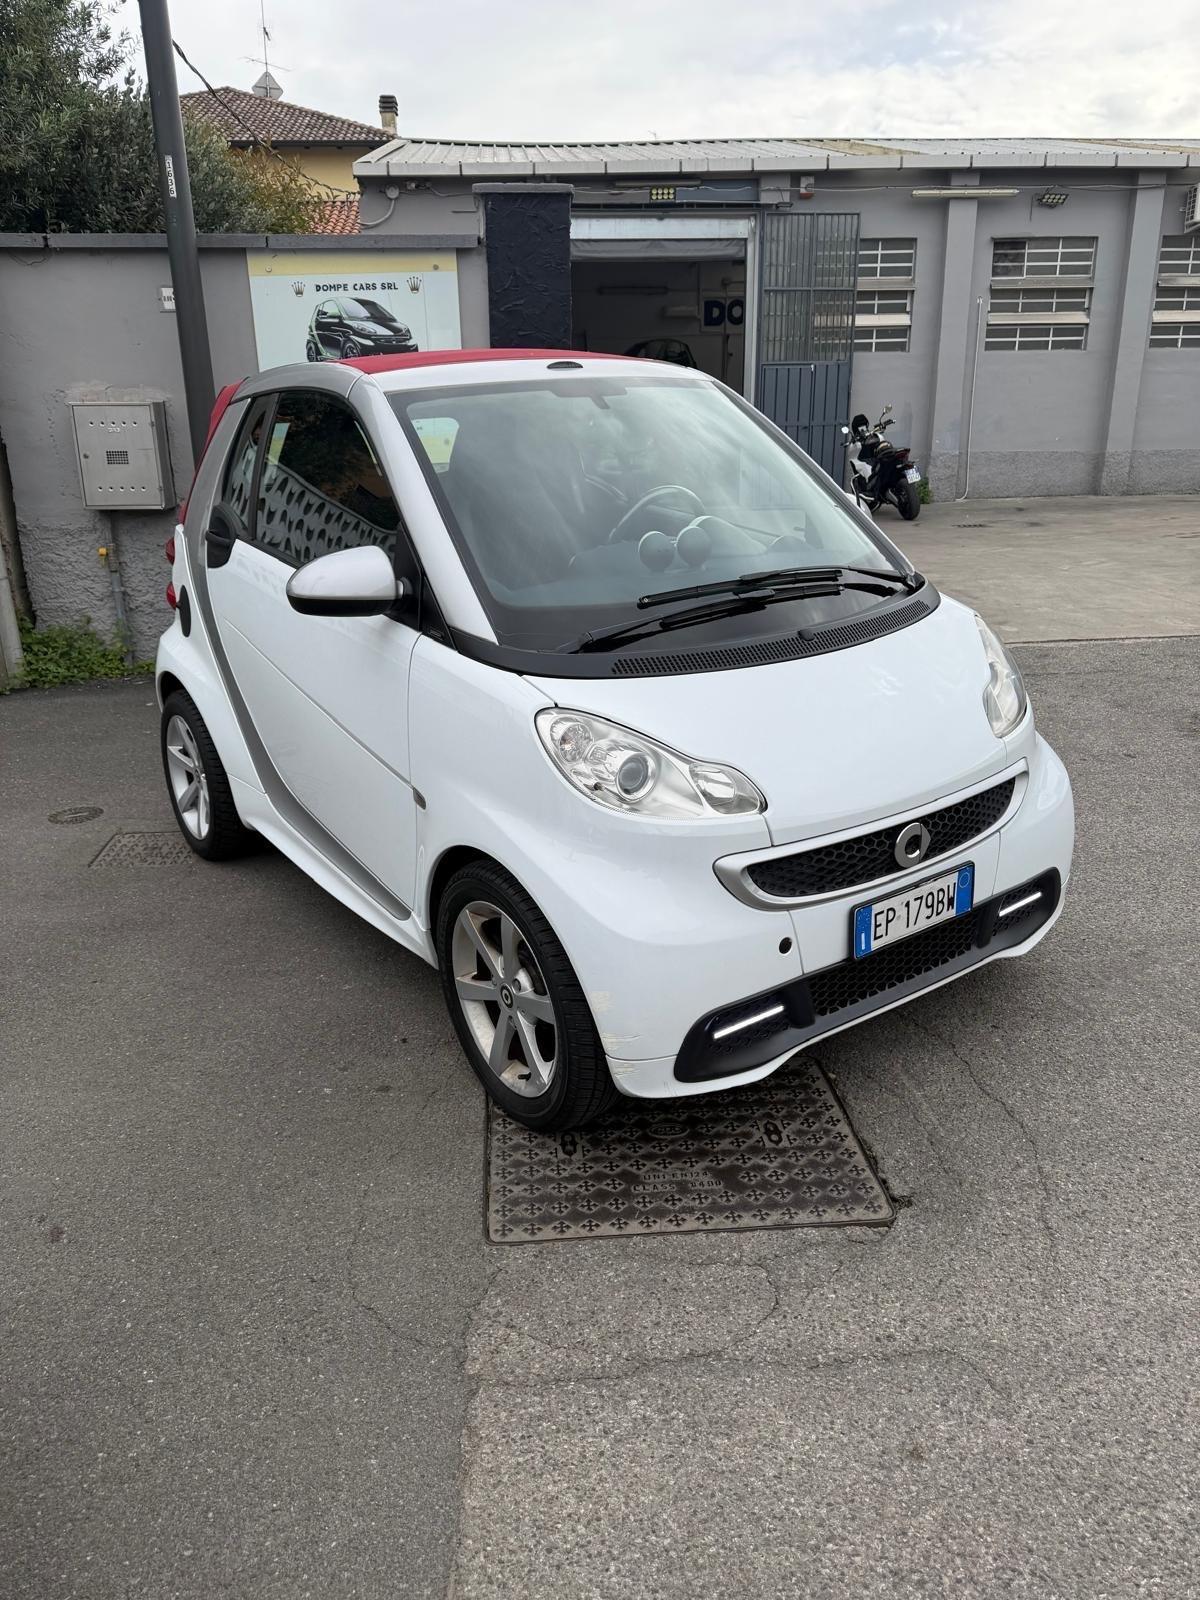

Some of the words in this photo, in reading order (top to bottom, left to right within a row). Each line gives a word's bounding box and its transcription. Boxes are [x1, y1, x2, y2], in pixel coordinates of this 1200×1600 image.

[166, 161, 175, 195] 1636
[315, 283, 349, 292] DOMPE
[353, 282, 377, 291] CARS
[380, 281, 398, 290] SRL
[873, 907, 897, 941] EP
[904, 882, 957, 929] 179BW
[632, 1183, 677, 1193] CLASS
